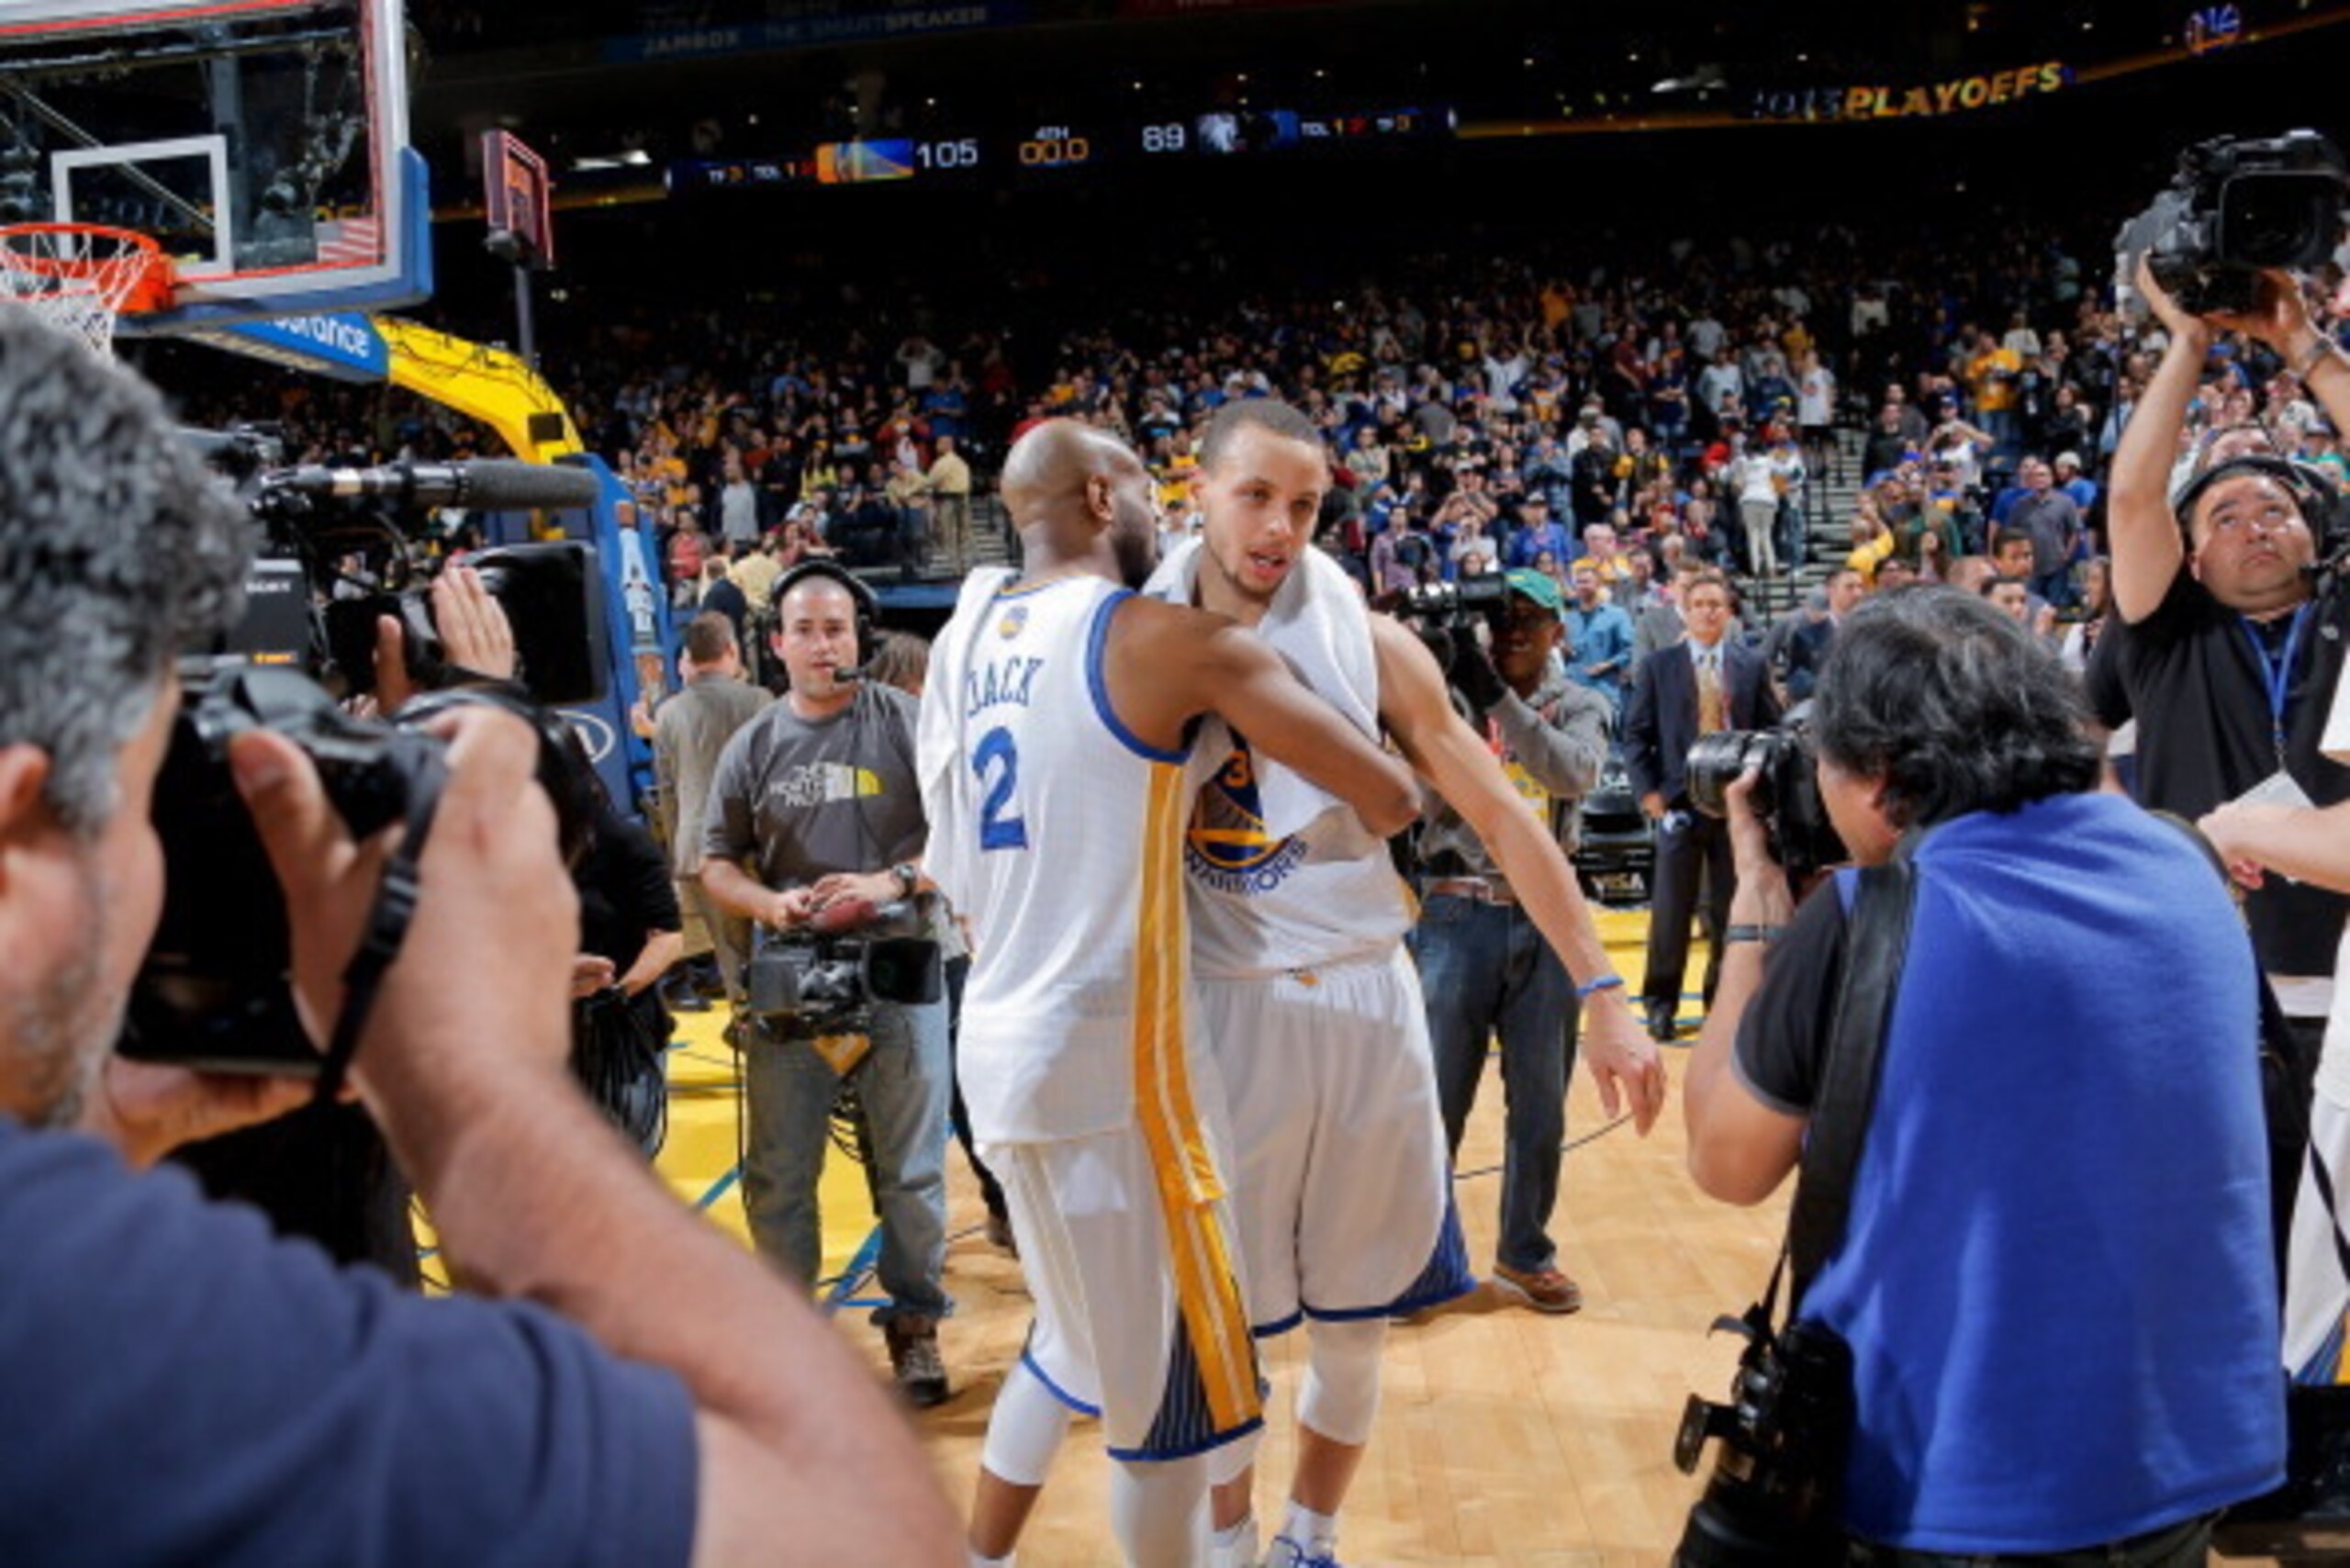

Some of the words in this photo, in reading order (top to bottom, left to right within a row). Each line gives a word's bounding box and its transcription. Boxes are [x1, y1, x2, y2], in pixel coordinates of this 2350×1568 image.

[644, 29, 740, 60] JAMBOX
[1844, 61, 2063, 120] PLAYOFFS
[1035, 125, 1069, 140] 4TH
[1141, 122, 1186, 153] 89
[916, 136, 979, 170] 105
[270, 314, 370, 359] urance
[244, 580, 291, 593] SONY
[967, 655, 1044, 718] JACK
[769, 780, 824, 795] NORTH
[972, 726, 1028, 851] 2
[1184, 834, 1308, 896] WARRIORS
